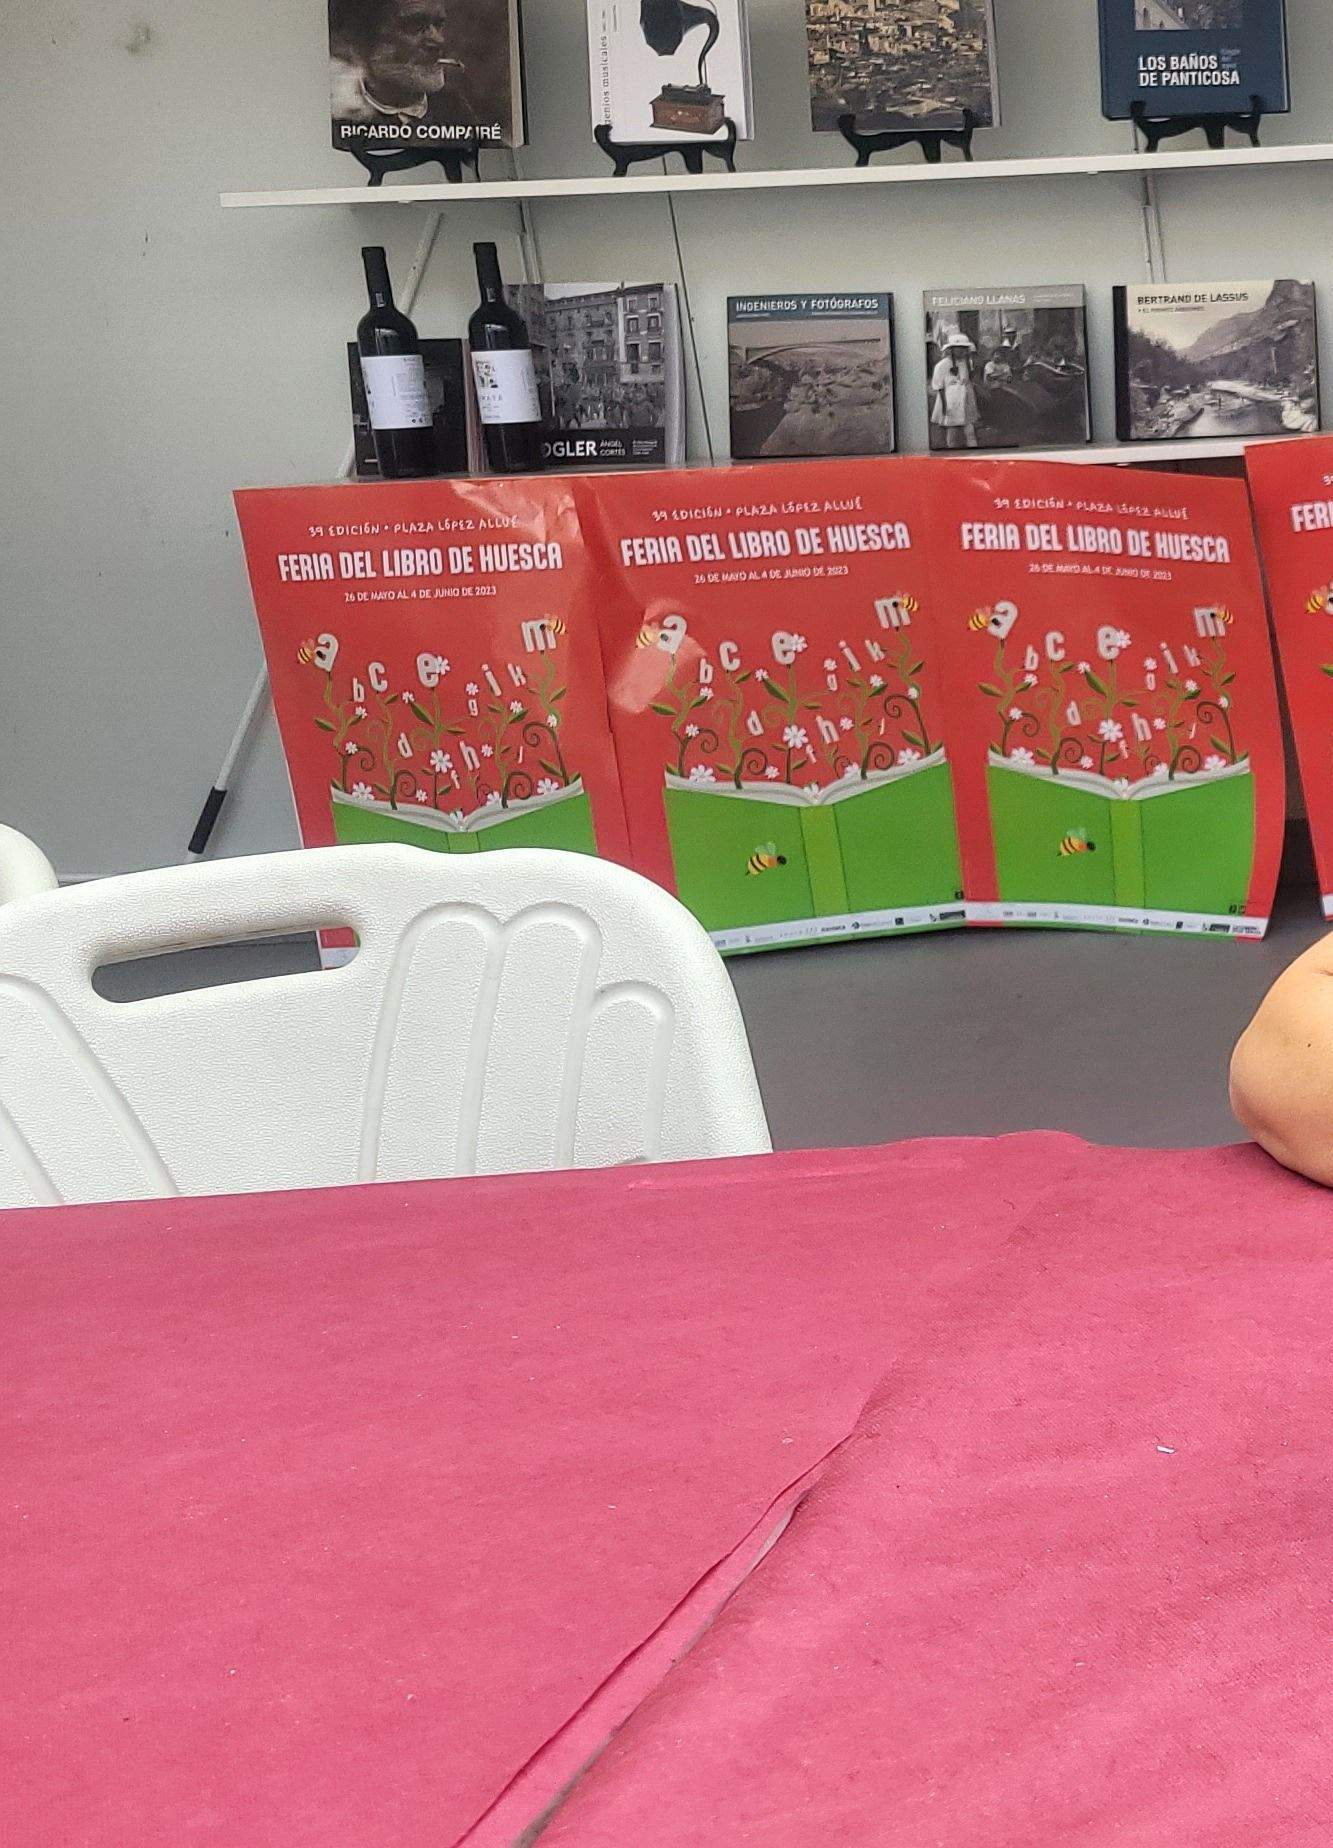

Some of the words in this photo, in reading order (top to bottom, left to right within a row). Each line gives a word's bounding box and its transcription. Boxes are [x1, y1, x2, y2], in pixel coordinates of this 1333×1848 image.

[600, 36, 609, 88] musicales
[1139, 55, 1166, 71] LOS
[1170, 52, 1218, 70] BAÑOS
[1139, 72, 1158, 86] DE
[1162, 70, 1240, 86] PANTICOSA
[341, 124, 411, 140] RICARDO
[736, 299, 797, 312] INGENIEROS
[800, 301, 807, 311] Y
[811, 297, 879, 310] FOTÓGRAFOS
[933, 296, 984, 306] FELICIANO
[987, 294, 1025, 304] LLANAS
[1138, 295, 1191, 305] BERTRAND
[1195, 294, 1207, 303] DE
[1211, 293, 1248, 302] LASSUS
[652, 510, 667, 521] 39
[672, 506, 722, 520] EDICIÓN
[736, 504, 777, 517] PLAZA
[781, 501, 819, 514] LÓPEZ
[824, 497, 863, 512] ALLUÉ
[994, 498, 1009, 508] 39
[1014, 497, 1064, 509] EDICIÓN
[1076, 501, 1113, 512] PLAZA
[1118, 503, 1149, 516] LÓPEZ
[1154, 507, 1188, 520] ALLUÉ
[309, 525, 323, 537] 39
[328, 522, 379, 536] EDICIÓN
[394, 521, 434, 534] PLAZA
[438, 518, 475, 532] LÓPEZ
[479, 515, 518, 529] ALLUÉ
[621, 536, 684, 566] FERIA
[686, 533, 725, 562] DEL
[729, 529, 790, 559] LIBRO
[795, 527, 823, 555] DE
[827, 522, 910, 552] HUESCA
[961, 522, 1019, 550] FERIA
[1026, 524, 1062, 550] DEL
[1067, 525, 1122, 554] LIBRO
[1127, 529, 1152, 556] DE
[1156, 531, 1230, 563] HUESCA
[278, 553, 334, 582] FERIA
[340, 550, 376, 579] DEL
[383, 547, 442, 577] LIBRO
[450, 546, 474, 574] DE
[480, 542, 562, 572] HUESCA
[345, 592, 355, 602] 26
[357, 591, 369, 601] DE
[371, 590, 395, 601] MAYO
[397, 590, 409, 600] AL
[420, 588, 431, 599] DE
[434, 587, 459, 598] JUNIO
[462, 586, 473, 597] DE
[475, 585, 496, 596] 2023
